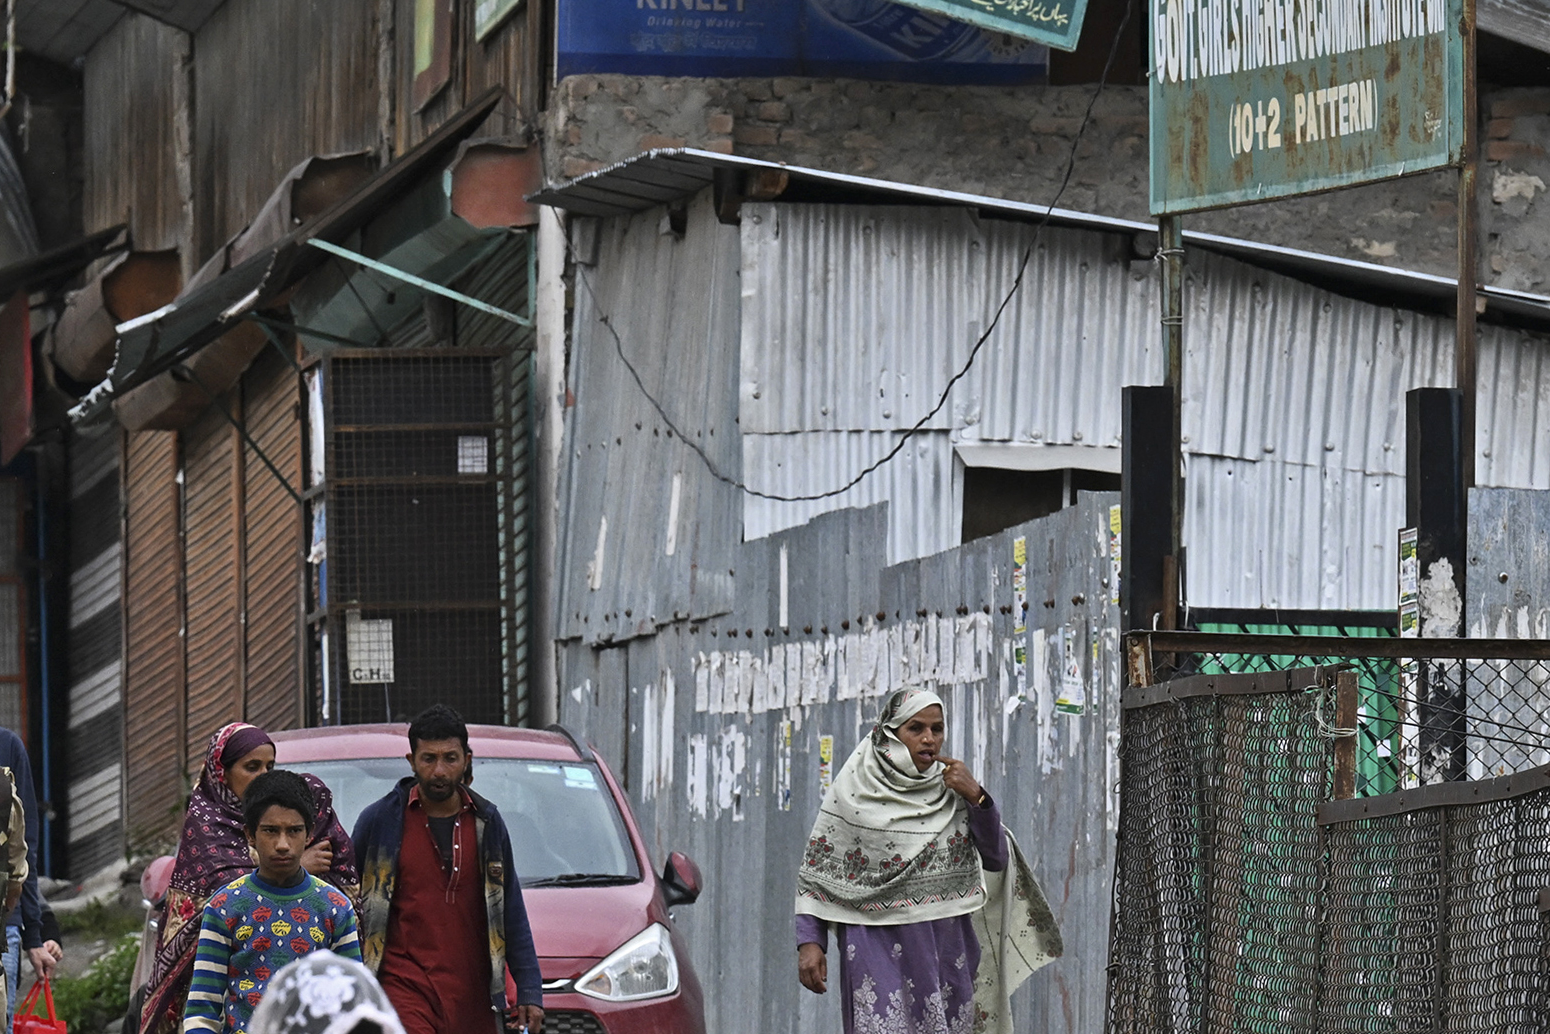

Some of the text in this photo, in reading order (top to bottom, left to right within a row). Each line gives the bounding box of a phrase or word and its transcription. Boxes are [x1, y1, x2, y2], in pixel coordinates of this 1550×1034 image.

[647, 15, 702, 30] Drinking
[705, 18, 742, 28] Water
[1154, 0, 1198, 84] GOVT.
[1198, 0, 1240, 77] GIRLS
[1242, 0, 1297, 71] HIGHER
[1229, 97, 1282, 159] (10+2
[1294, 78, 1378, 144] PATTERN)
